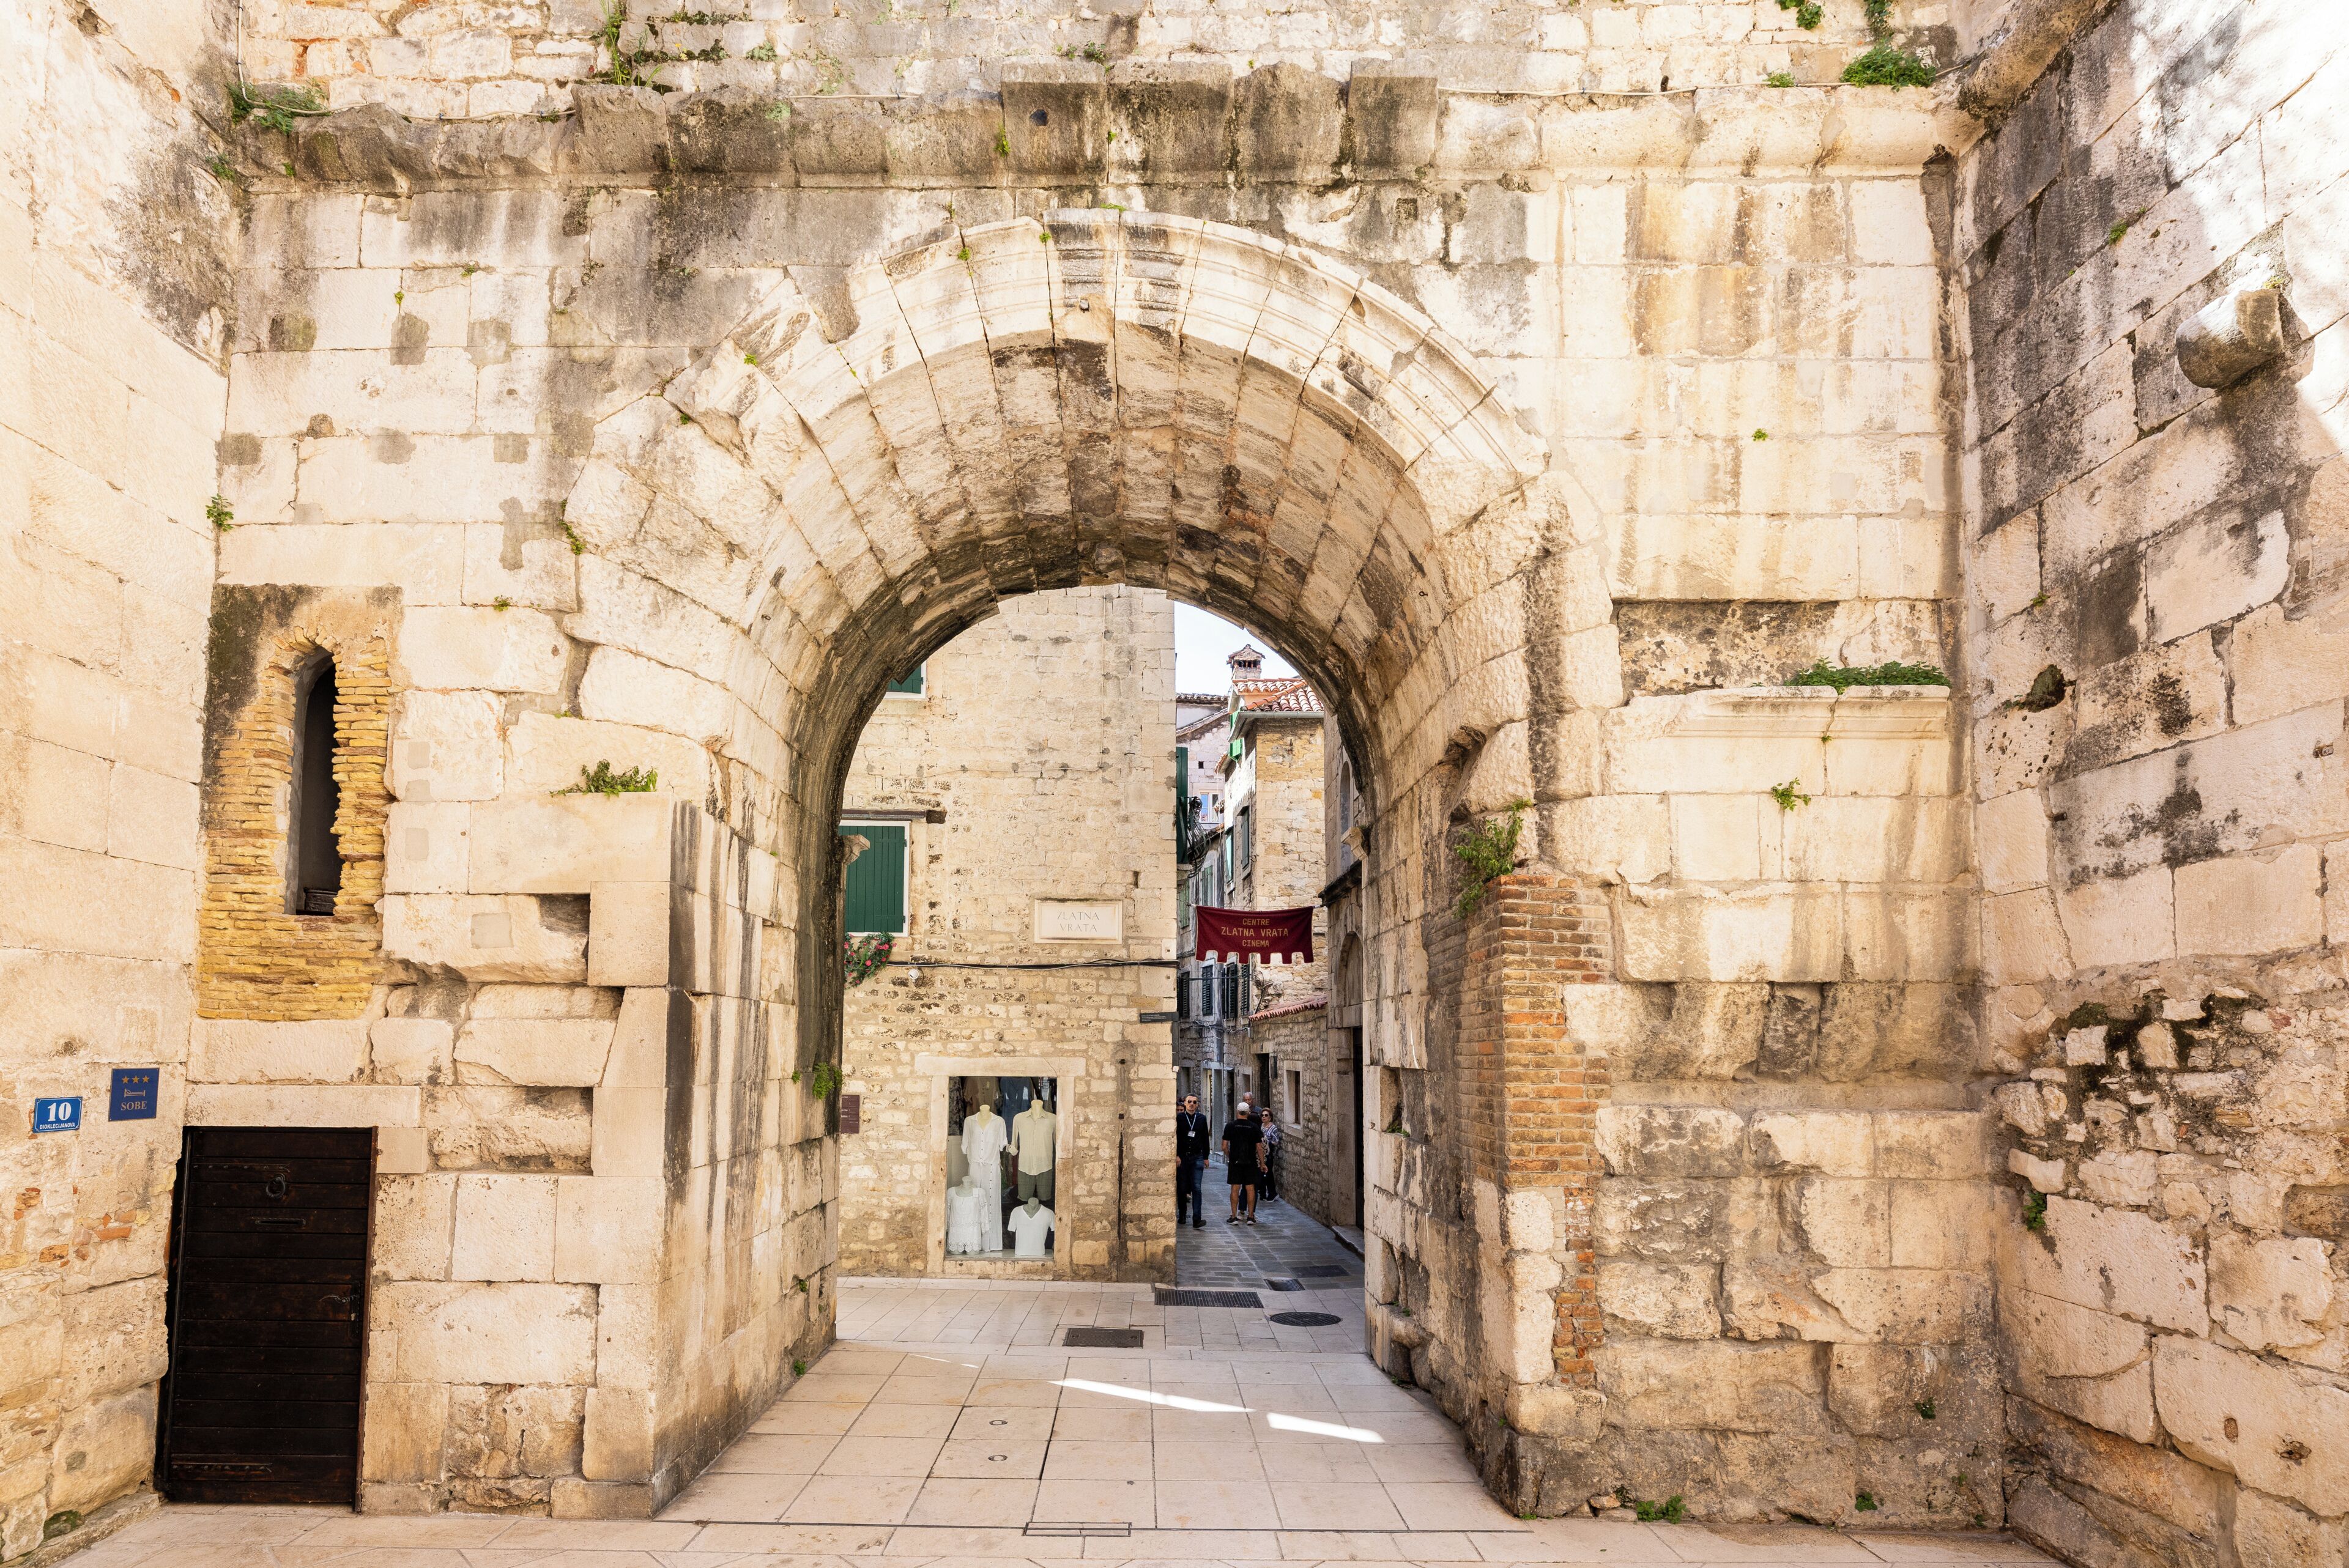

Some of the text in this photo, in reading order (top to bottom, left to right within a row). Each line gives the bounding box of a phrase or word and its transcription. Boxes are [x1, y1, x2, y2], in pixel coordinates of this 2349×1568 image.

[1059, 923, 1097, 933] VRATA
[1221, 926, 1288, 937] ZLATNA VRATA
[121, 1101, 147, 1111] SOBE
[47, 1101, 72, 1122] 10
